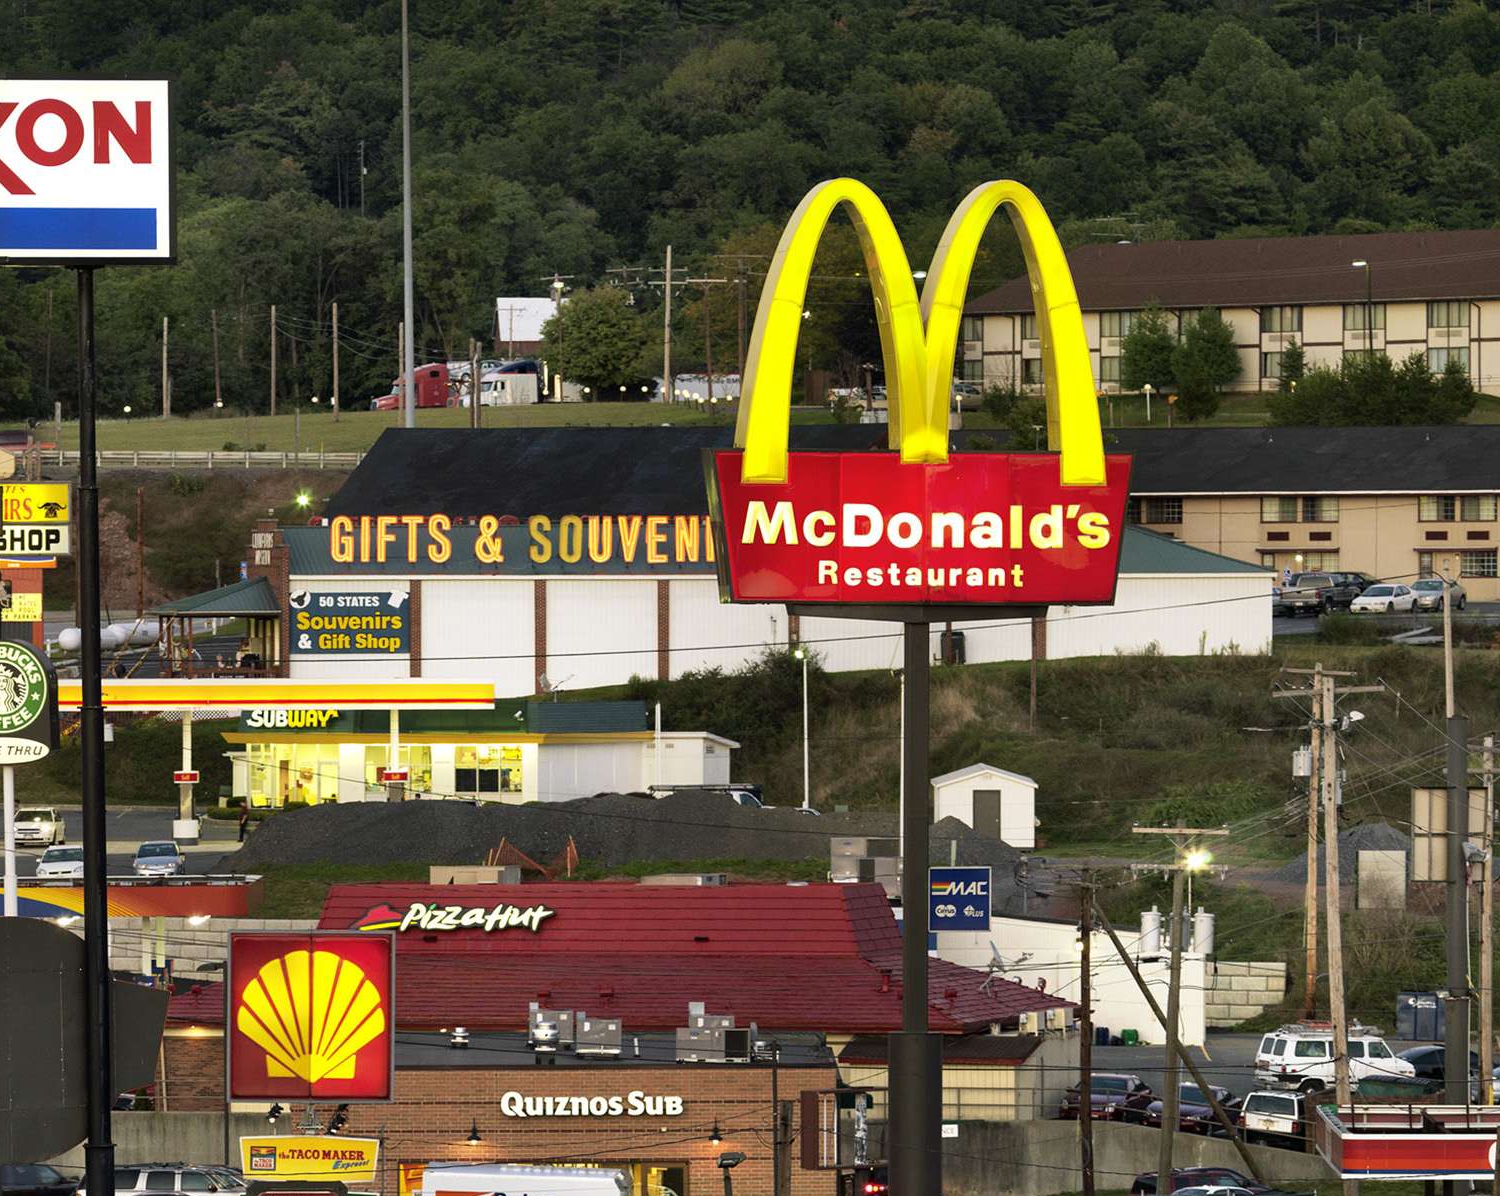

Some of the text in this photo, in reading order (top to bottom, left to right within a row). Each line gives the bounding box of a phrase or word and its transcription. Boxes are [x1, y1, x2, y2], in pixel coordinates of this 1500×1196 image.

[740, 500, 1111, 550] McDonald's
[330, 512, 453, 564] GIFTS
[474, 513, 505, 564] &
[818, 559, 1025, 588] Restaurant
[318, 595, 380, 608] 50 STATES
[296, 611, 403, 631] Souvenirs
[297, 632, 401, 653] & Gift Shop
[246, 709, 339, 729] SUBWAY
[7, 744, 44, 756] THRU
[946, 881, 988, 896] MAC
[399, 902, 554, 932] Pizza Hut
[627, 1090, 684, 1117] SUB
[278, 1149, 365, 1161] the TACO MAKER
